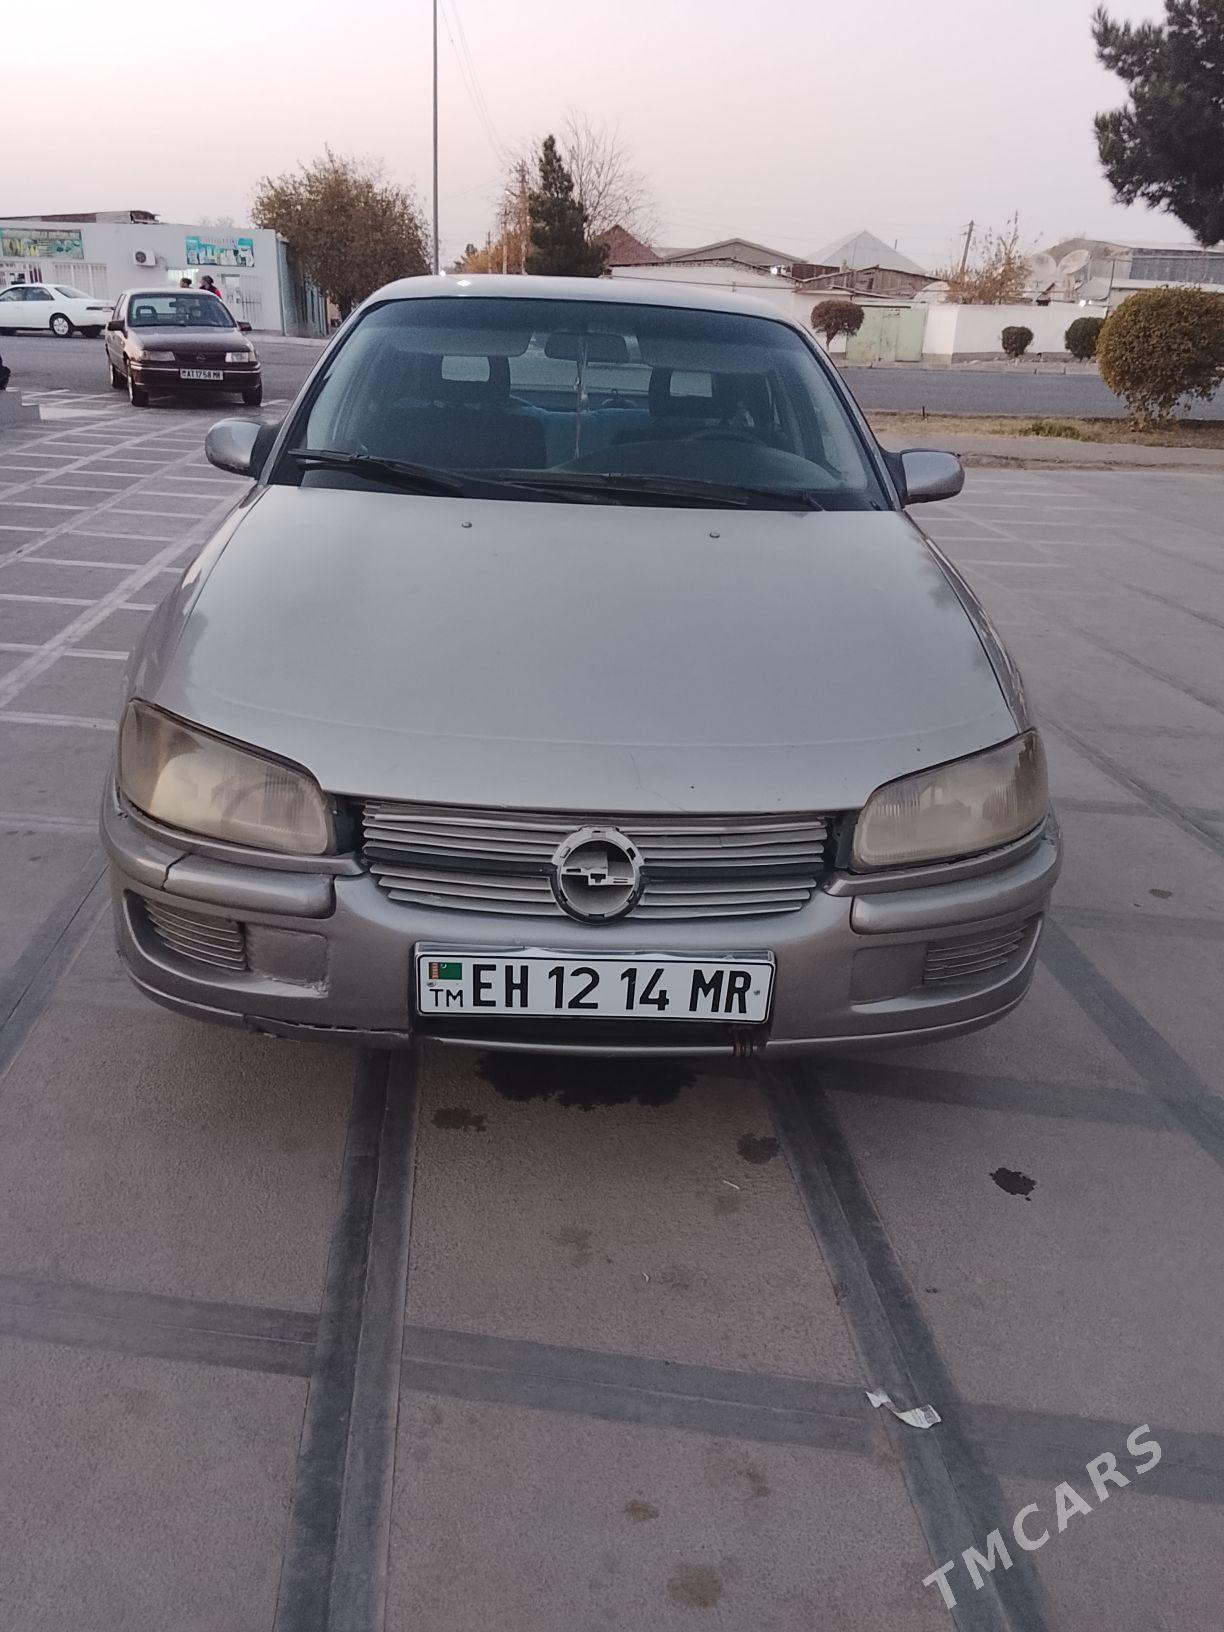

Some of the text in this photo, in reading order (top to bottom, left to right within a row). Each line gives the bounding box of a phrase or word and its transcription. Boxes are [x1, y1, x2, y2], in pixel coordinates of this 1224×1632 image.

[429, 988, 464, 1008] TM
[472, 963, 752, 1014] EH 12 14 MR
